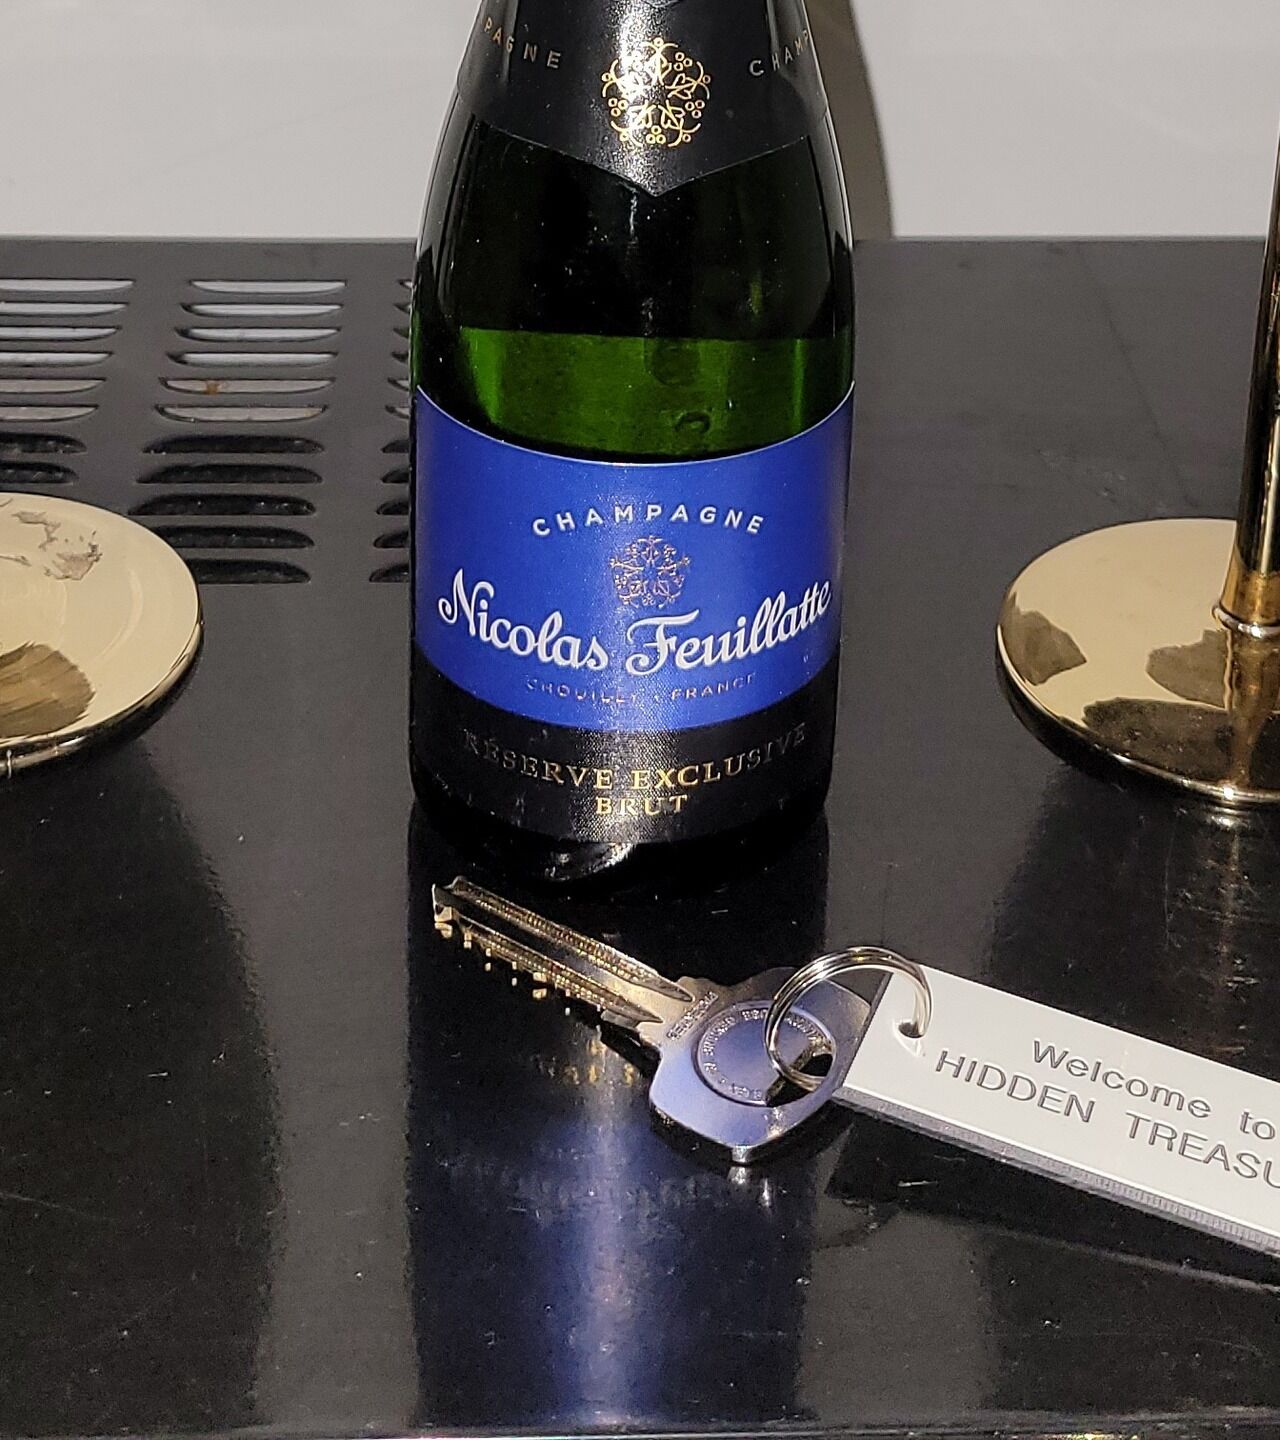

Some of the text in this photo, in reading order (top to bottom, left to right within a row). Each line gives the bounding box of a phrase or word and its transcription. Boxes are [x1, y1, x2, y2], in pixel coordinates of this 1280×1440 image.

[483, 16, 561, 69] PAGNE
[532, 504, 764, 536] CHAMPAGNE
[437, 568, 833, 676] Nicolas Feuillatte
[631, 721, 807, 790] EXCLUSIVE
[595, 793, 689, 817] BRUT
[934, 1049, 1095, 1124] HIDDEN
[1033, 1039, 1277, 1142] Welcome to
